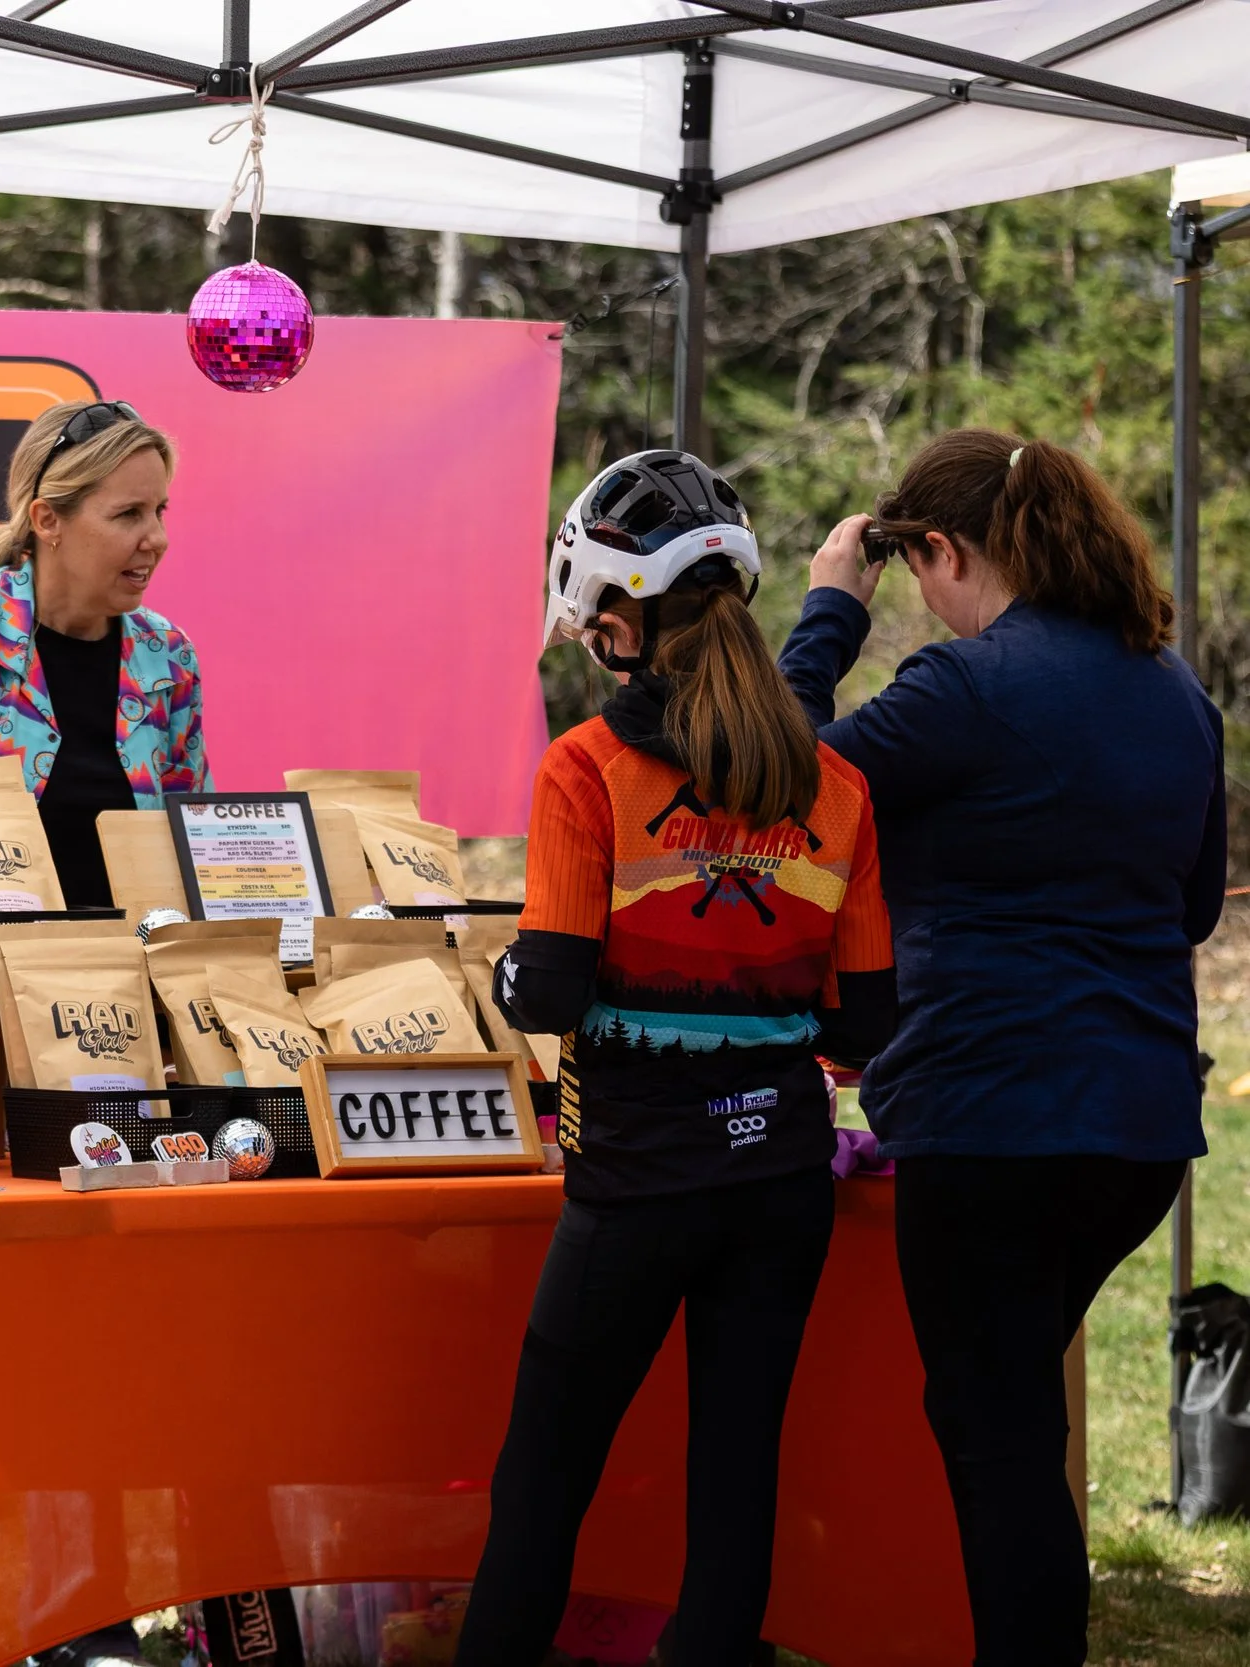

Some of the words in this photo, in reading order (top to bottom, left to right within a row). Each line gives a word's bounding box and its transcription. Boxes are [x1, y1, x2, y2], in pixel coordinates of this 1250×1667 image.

[556, 518, 576, 547] OC
[214, 803, 286, 819] COFFEE
[741, 825, 808, 860] LAKES
[51, 1000, 142, 1041] RAD
[351, 1006, 450, 1054] RAD
[78, 1027, 130, 1058] Gal
[387, 1030, 438, 1054] Gal
[278, 1048, 312, 1072] Ga
[339, 1089, 515, 1141] COFFEE
[558, 1067, 583, 1154] LAKES
[708, 1093, 745, 1116] MN
[745, 1093, 777, 1106] CYCLING
[101, 1134, 120, 1150] Gal
[161, 1134, 206, 1158] RAD
[731, 1134, 767, 1149] podium
